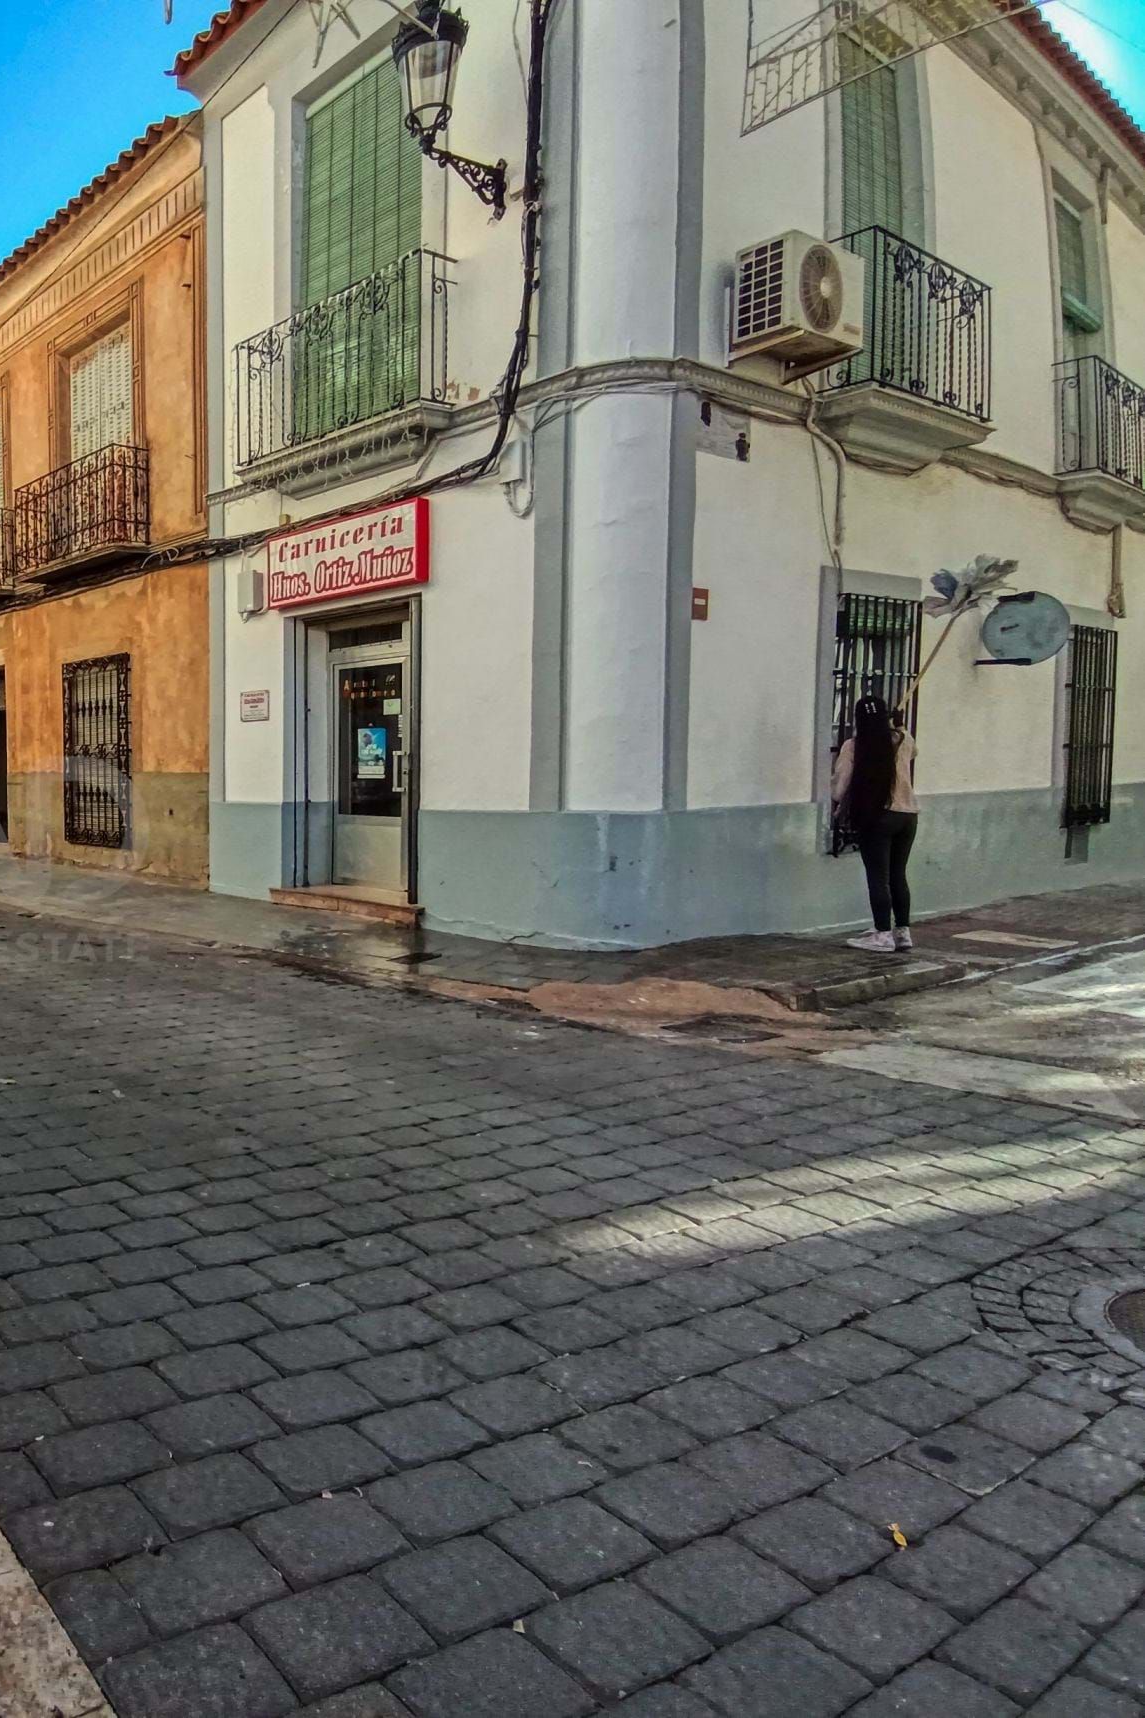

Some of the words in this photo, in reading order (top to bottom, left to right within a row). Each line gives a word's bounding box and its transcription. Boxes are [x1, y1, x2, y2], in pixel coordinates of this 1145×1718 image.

[278, 515, 404, 562] Carnicería
[271, 571, 311, 602] Hnos.
[314, 556, 354, 593] Ortiz
[353, 545, 415, 586] Muñoz
